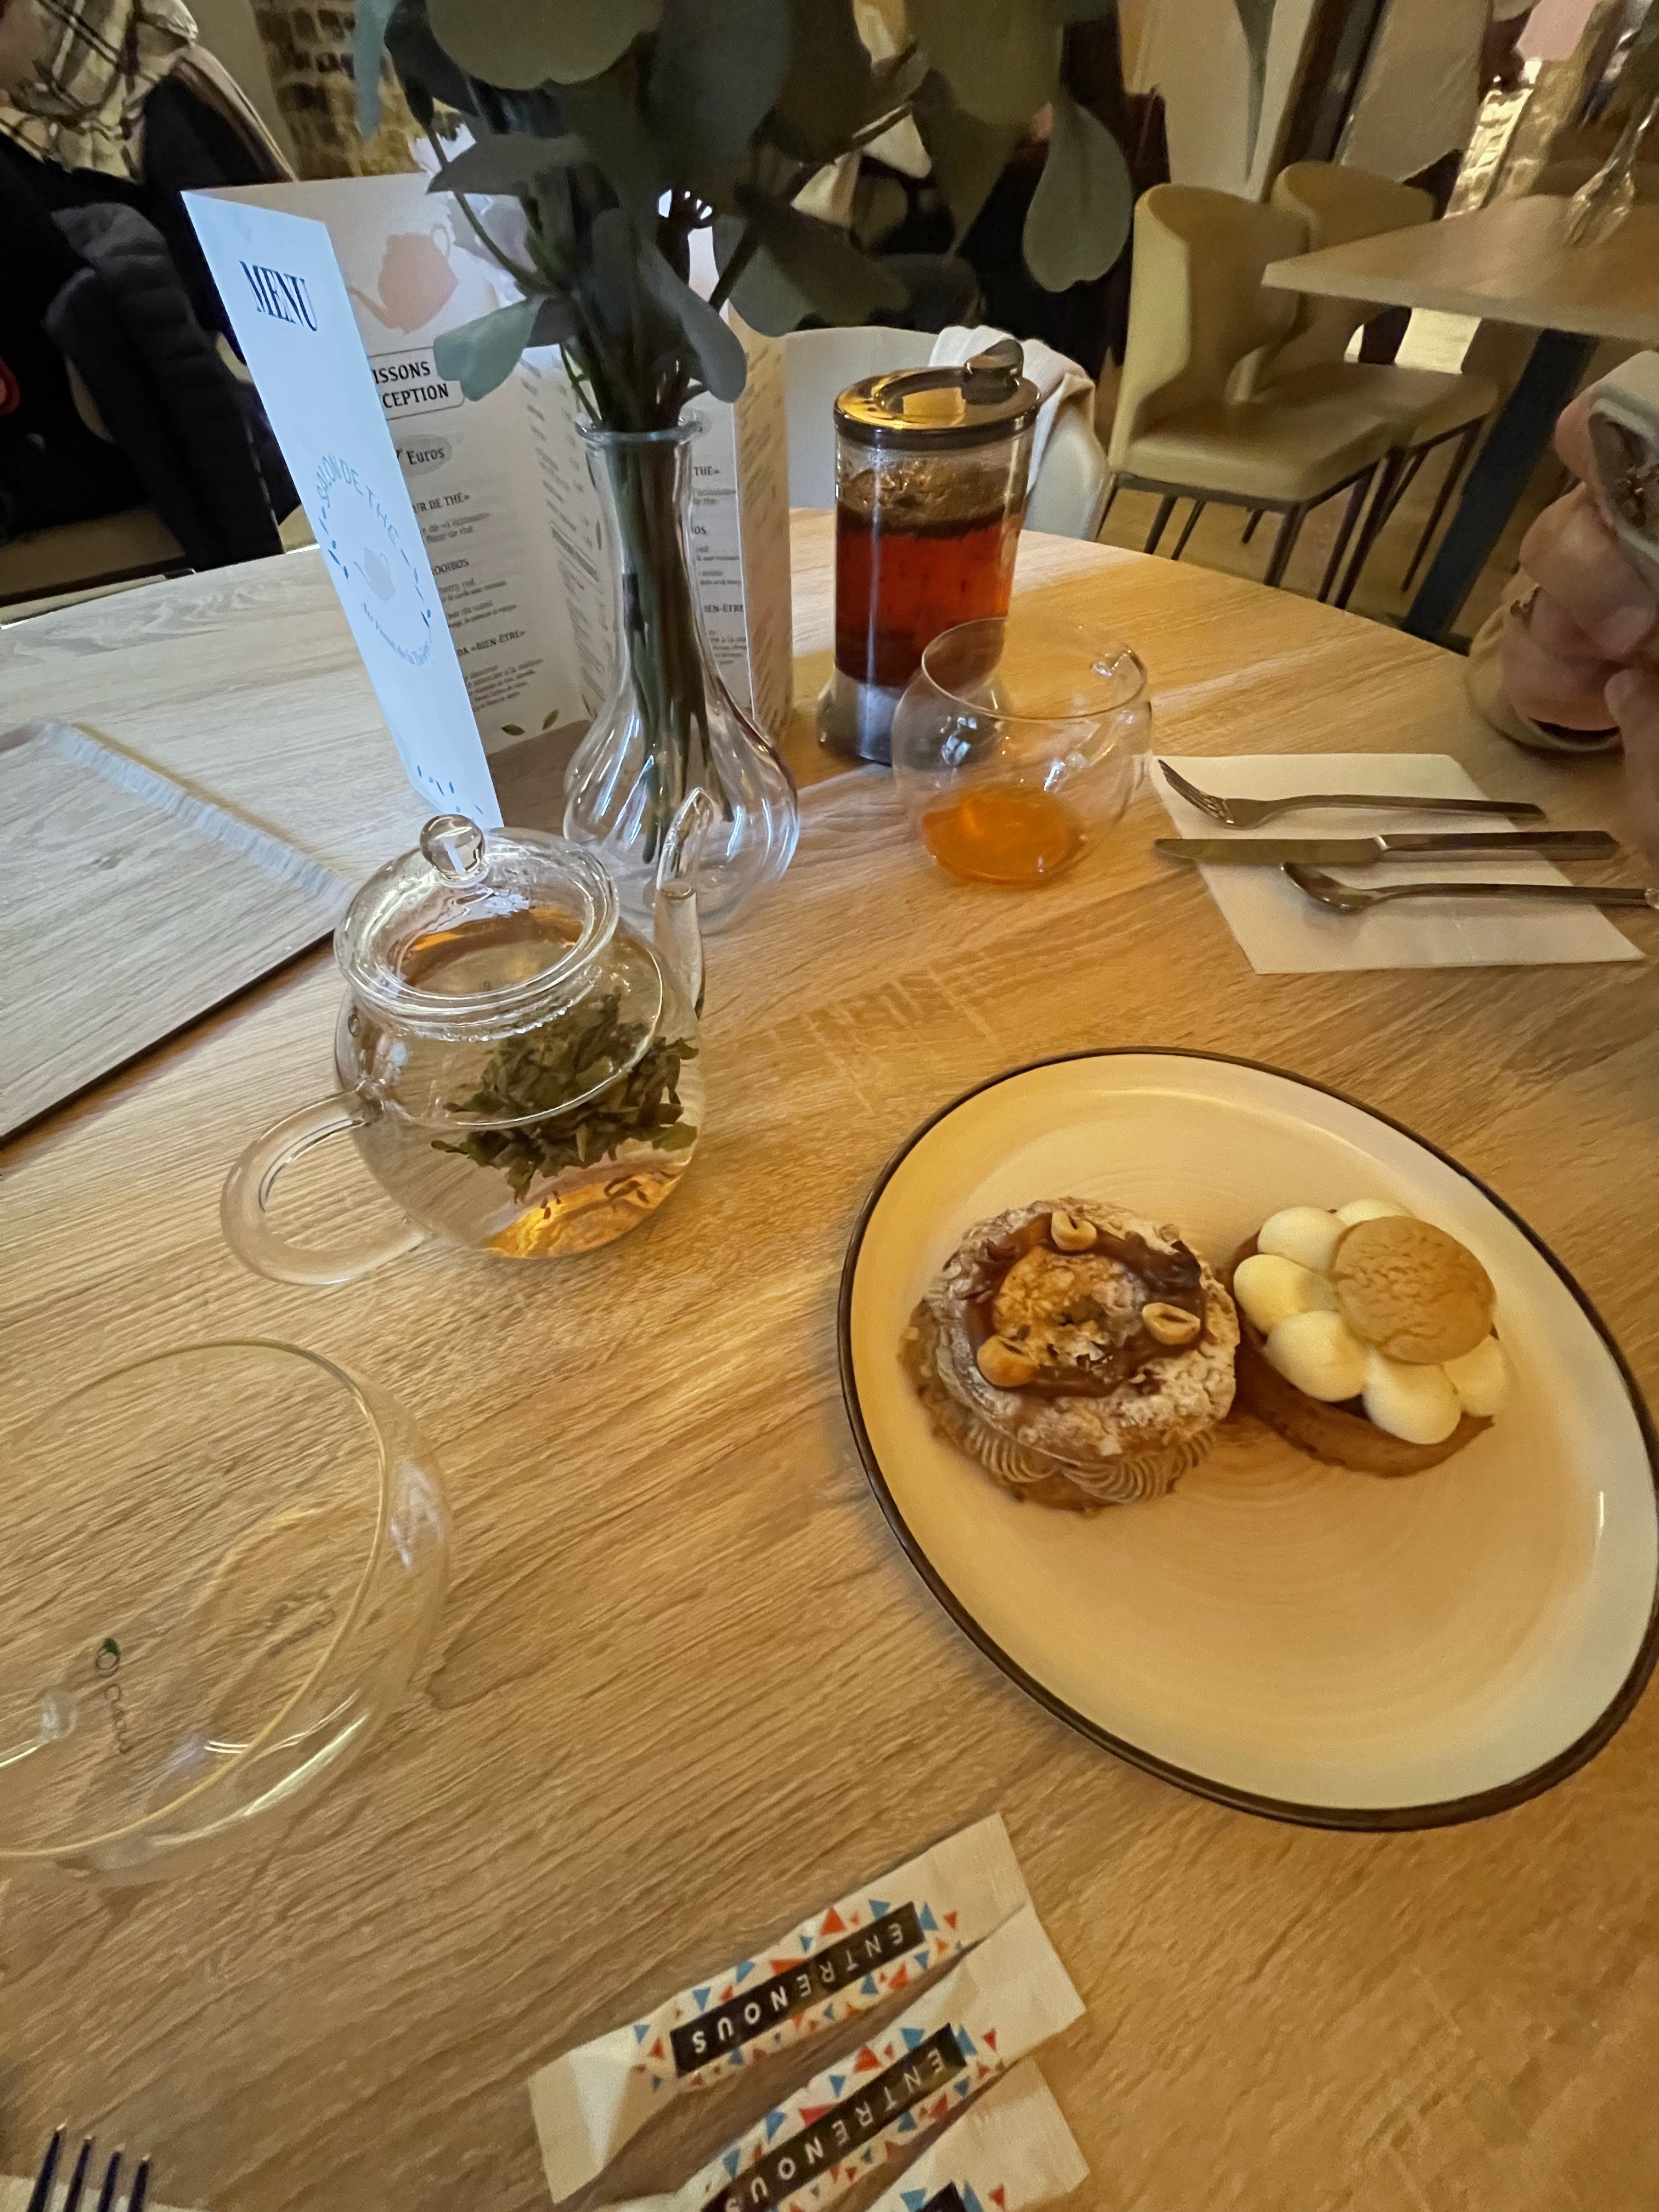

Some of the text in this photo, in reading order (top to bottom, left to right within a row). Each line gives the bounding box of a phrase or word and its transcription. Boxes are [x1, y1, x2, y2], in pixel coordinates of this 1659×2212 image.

[239, 261, 317, 331] MENU
[382, 383, 449, 408] CEPTION
[407, 447, 445, 465] Euros
[428, 497, 443, 510] DE
